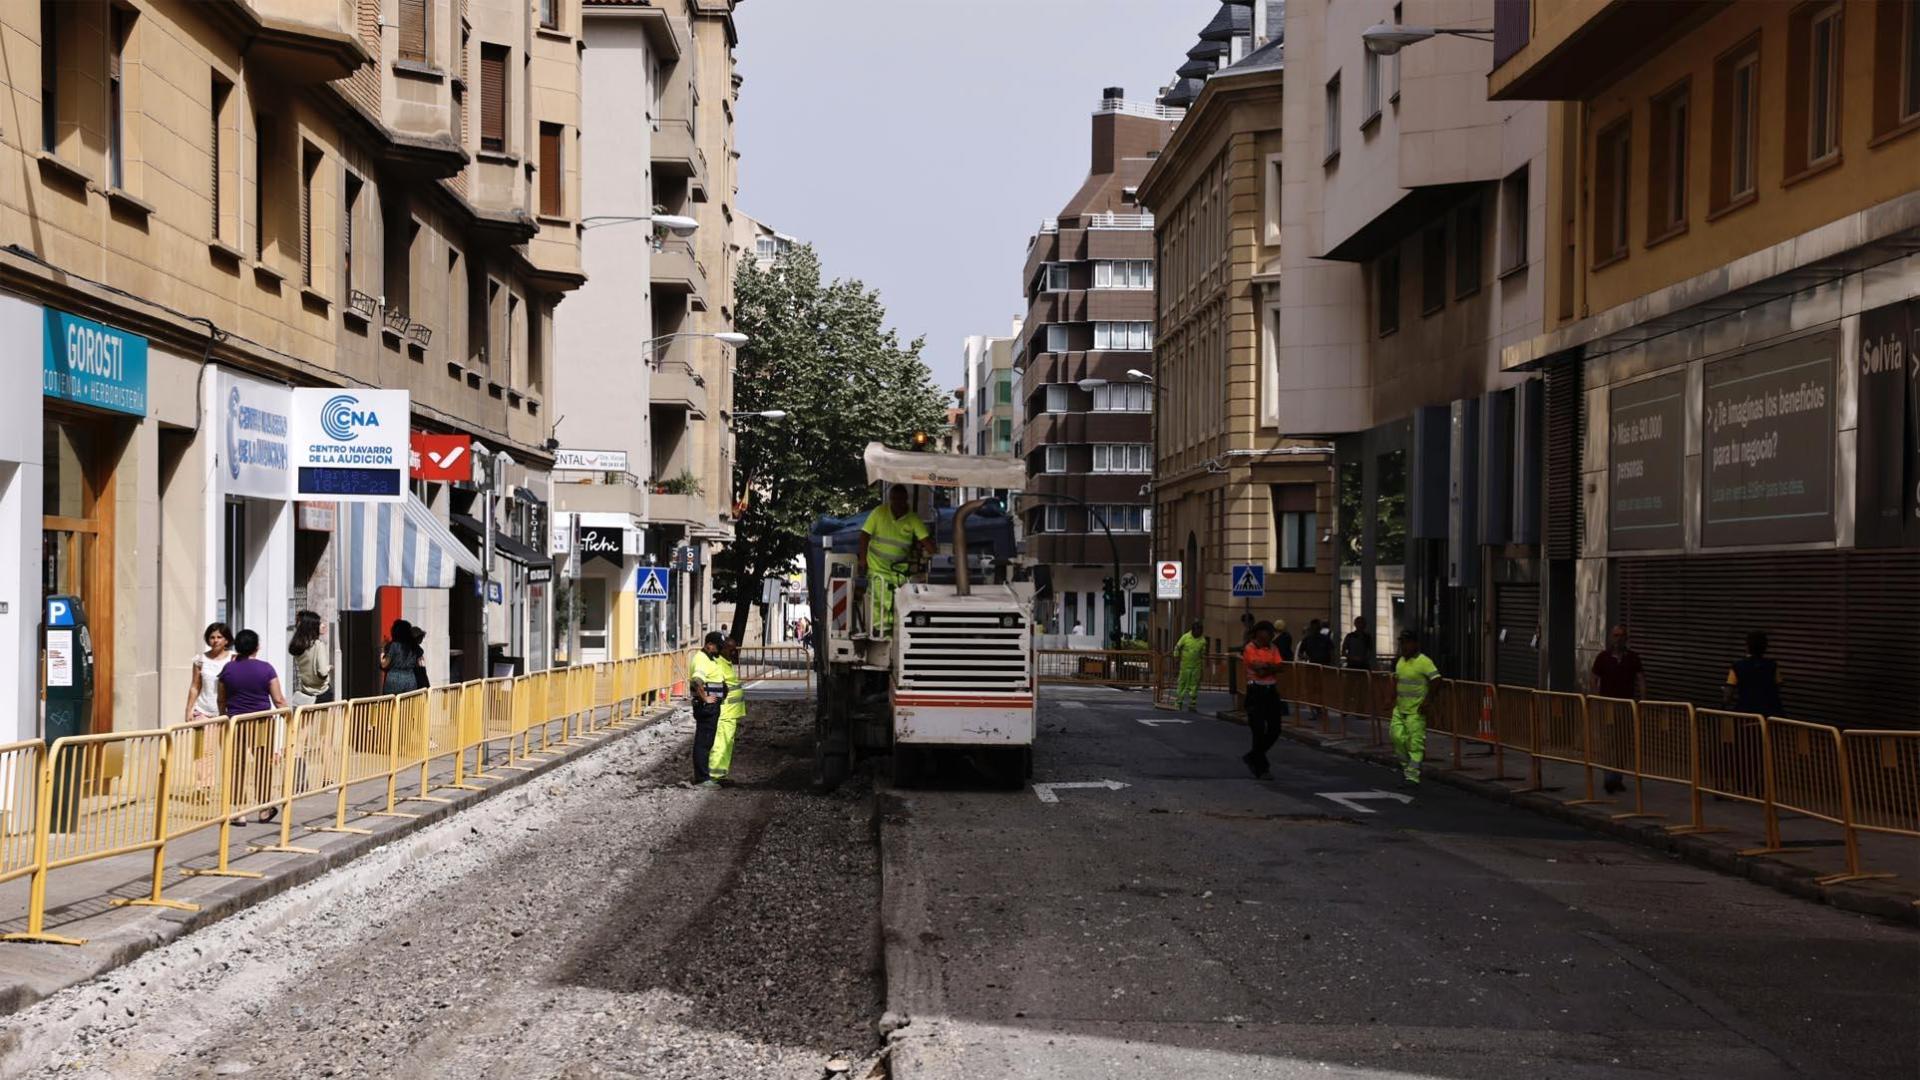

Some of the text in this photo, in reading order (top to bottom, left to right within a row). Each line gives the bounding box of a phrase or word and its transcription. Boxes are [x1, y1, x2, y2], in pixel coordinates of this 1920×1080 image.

[68, 323, 123, 381] GOROSTI
[1862, 333, 1902, 375] Solvia
[43, 368, 81, 397] COTIENDA
[1764, 390, 1777, 417] los
[1779, 380, 1825, 415] beneficios
[336, 411, 379, 426] CNA
[309, 445, 393, 455] CENTRO NAVARRO
[309, 455, 393, 464] DE LA AUDICION
[553, 452, 586, 466] ENTAL
[1713, 445, 1730, 472] para
[1741, 431, 1778, 468] negocio?
[50, 602, 66, 624] P
